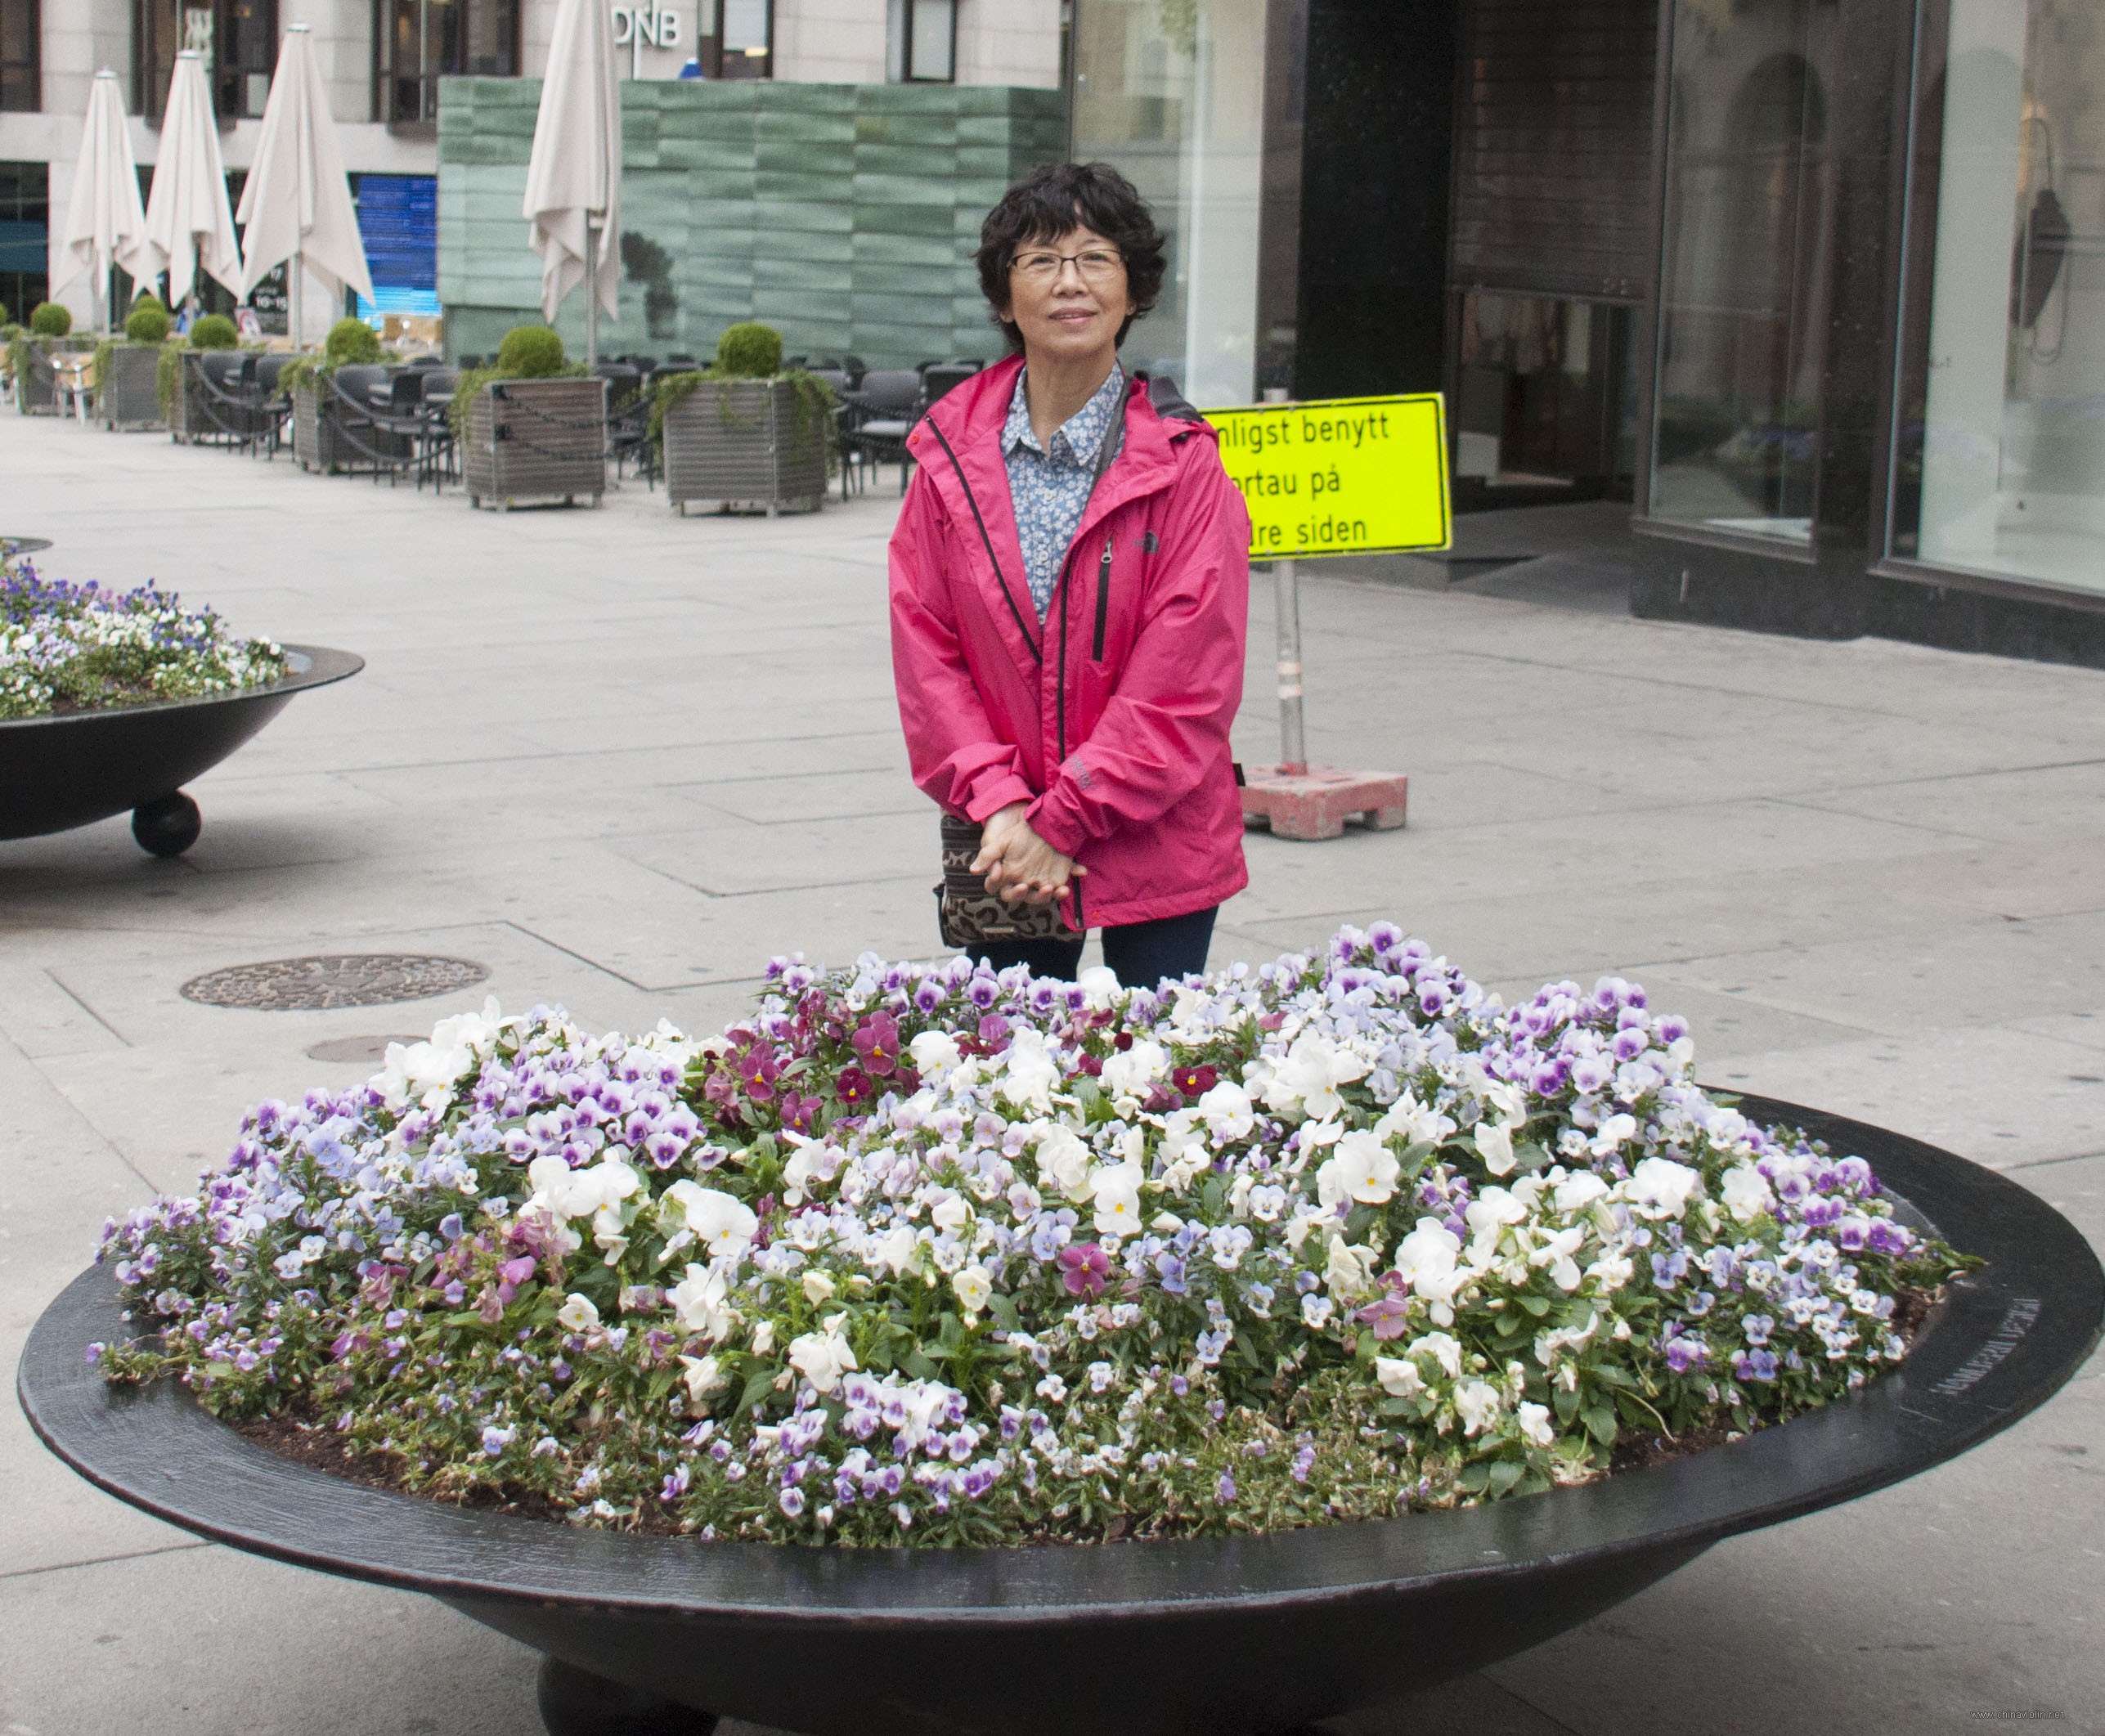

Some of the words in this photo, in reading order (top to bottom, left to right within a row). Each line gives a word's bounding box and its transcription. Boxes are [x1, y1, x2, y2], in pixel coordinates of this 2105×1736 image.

[611, 7, 682, 47] DNB
[1302, 411, 1389, 448] benytt
[1311, 464, 1341, 500] på
[1296, 514, 1367, 545] siden
